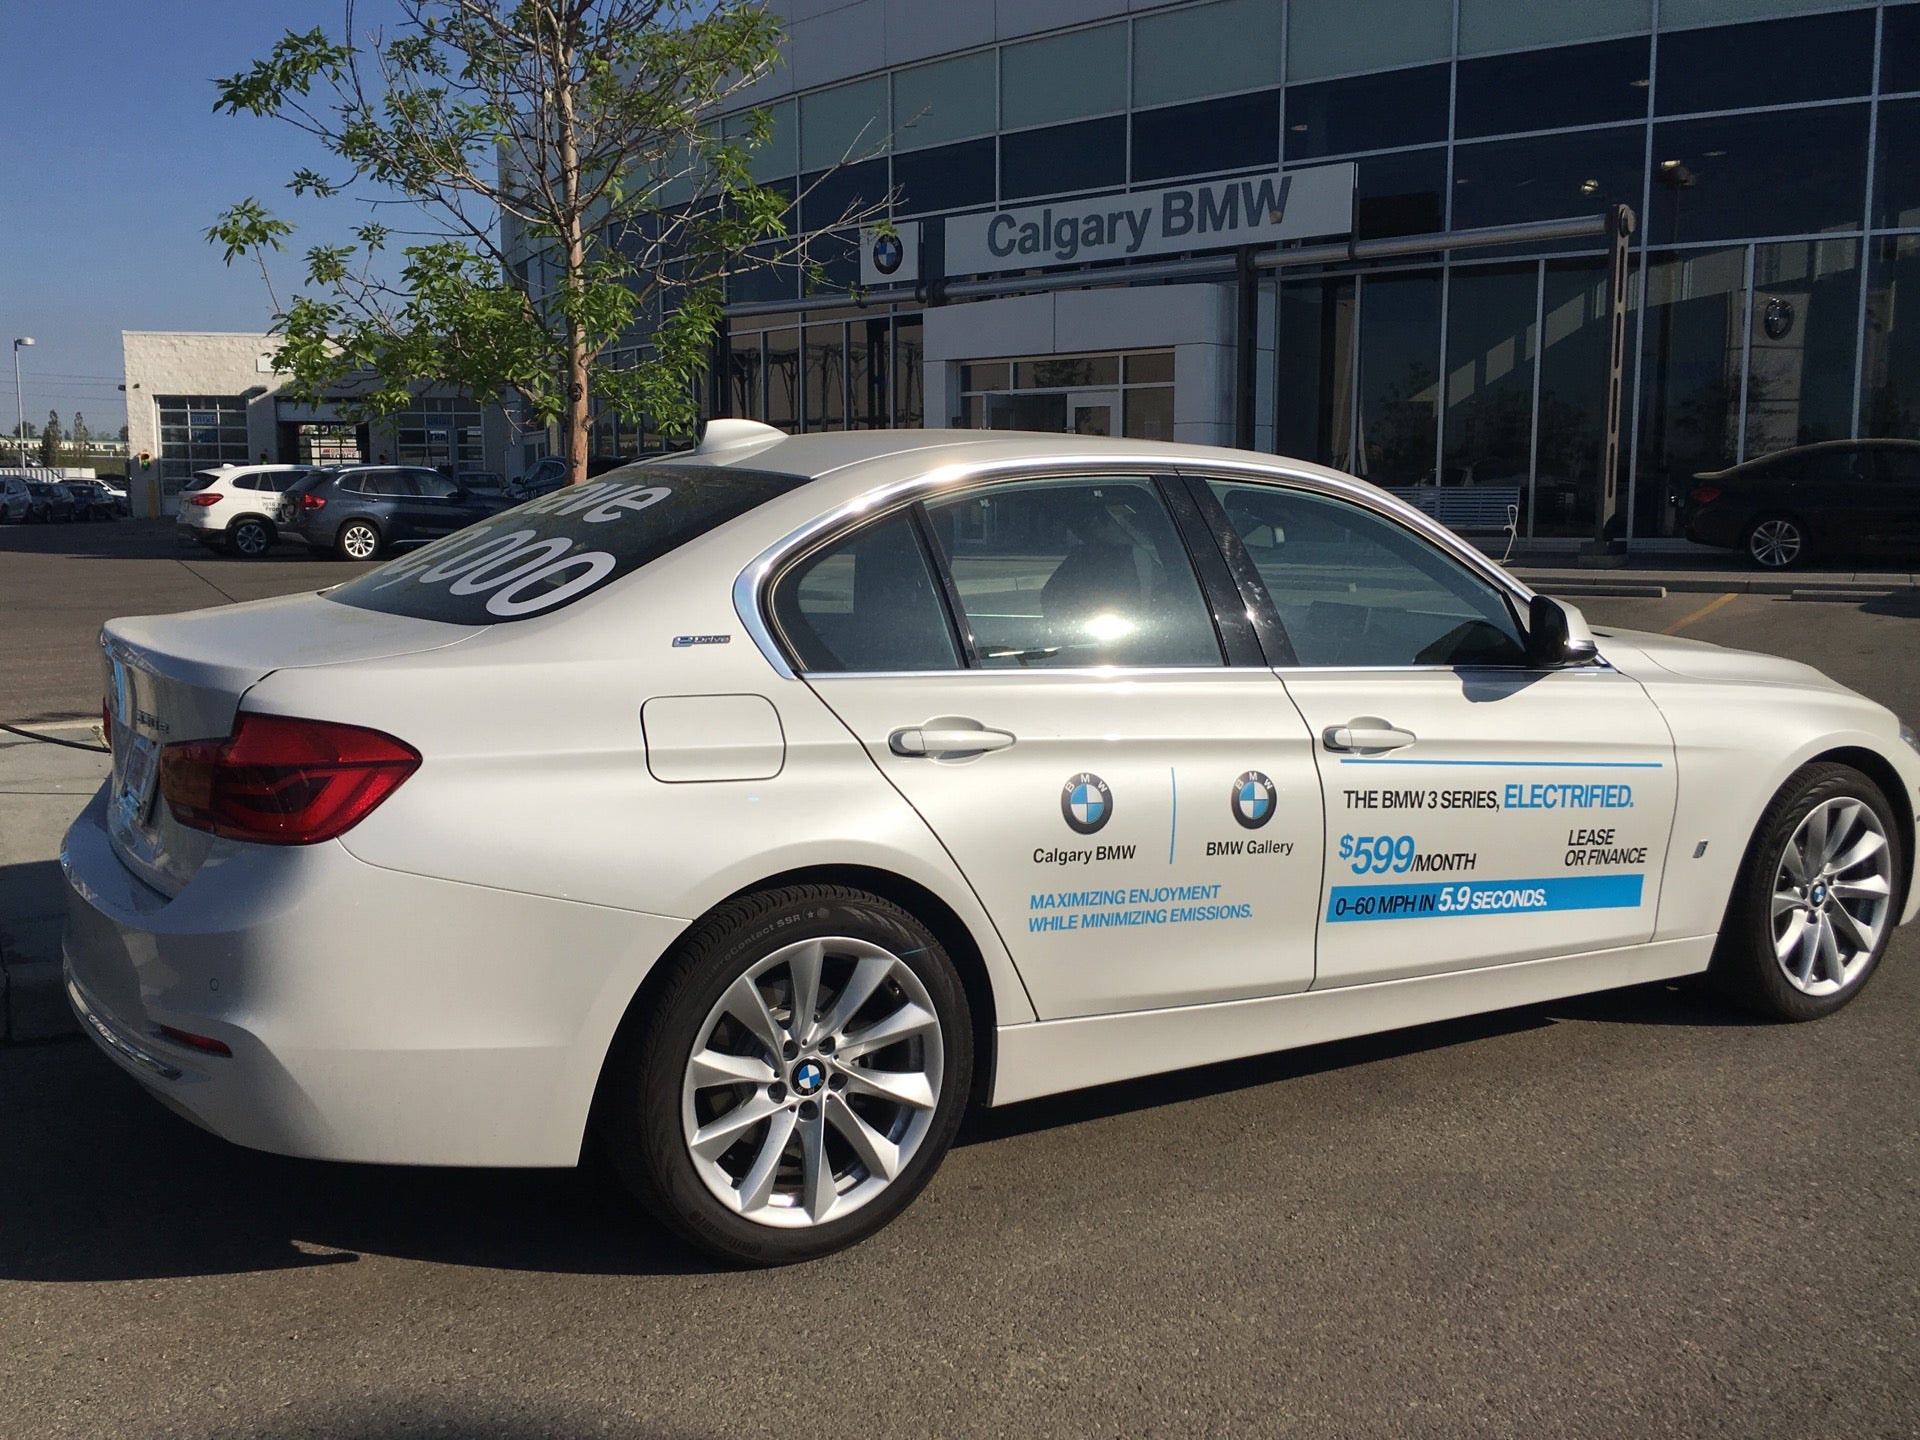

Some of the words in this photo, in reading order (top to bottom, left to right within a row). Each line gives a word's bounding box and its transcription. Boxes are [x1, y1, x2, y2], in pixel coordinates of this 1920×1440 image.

[987, 208, 1151, 260] Calgary
[1162, 176, 1292, 237] BMW
[1344, 790, 1379, 809] THE
[1382, 791, 1425, 809] BMW
[1428, 791, 1438, 809] 3
[1441, 791, 1500, 812] SERIES,
[1504, 784, 1634, 809] ELECTRIFIED.
[1206, 841, 1244, 856] BMW
[1247, 840, 1294, 856] Gallery
[1568, 829, 1615, 846] LEASE
[1033, 848, 1092, 865] Calgary
[1096, 845, 1136, 861] BMW
[1564, 850, 1585, 866] OR
[1588, 848, 1647, 866] FINANCE
[1030, 889, 1125, 909] MAXIMIZING
[1129, 885, 1221, 904] ENJOYMENT
[1378, 895, 1416, 914] MPH
[1418, 894, 1436, 911] IN
[1438, 886, 1471, 912] 5.9
[1471, 889, 1548, 910] SECONDS.
[1029, 915, 1078, 932] WHILE
[1081, 909, 1167, 929] MINIMIZING
[1170, 904, 1253, 923] EMISSIONS.
